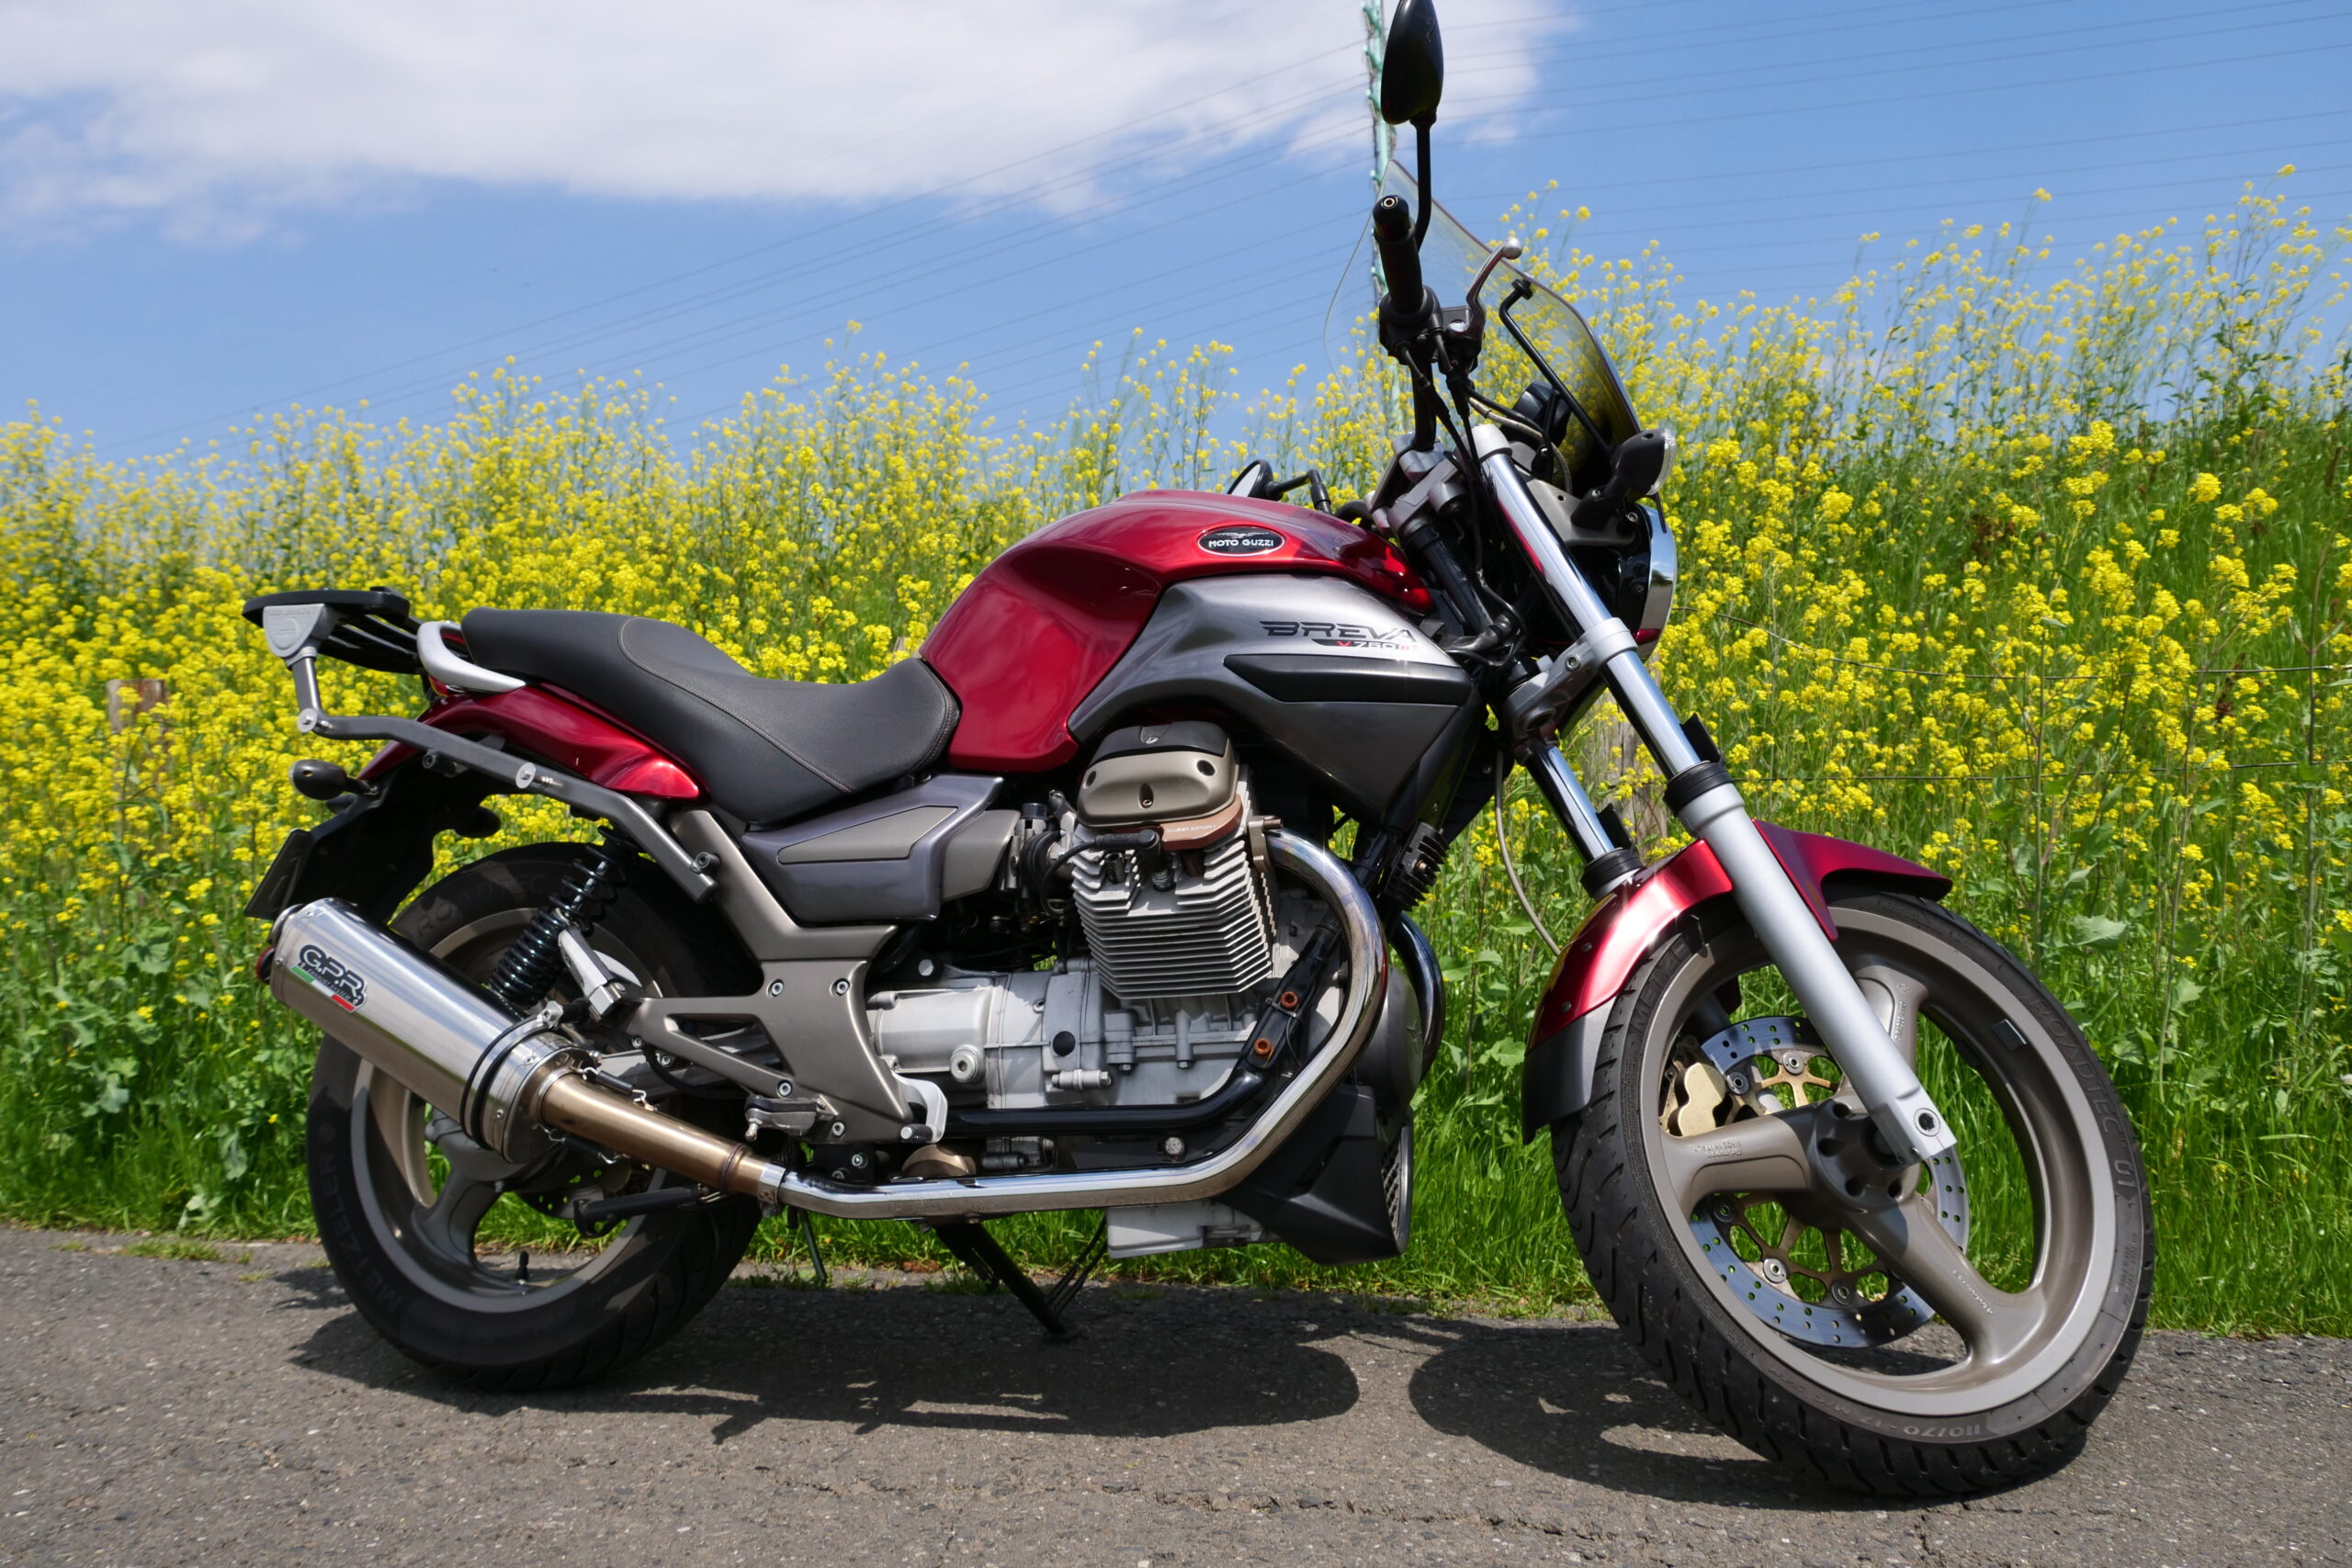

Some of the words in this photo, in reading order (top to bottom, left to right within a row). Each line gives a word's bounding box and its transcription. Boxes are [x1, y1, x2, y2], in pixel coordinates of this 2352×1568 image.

[1208, 539, 1239, 547] MOTO
[1259, 620, 1418, 642] BREVA
[331, 984, 351, 1000] SYSTEM
[2027, 998, 2122, 1133] ROADTEC
[2112, 1159, 2137, 1190] 01
[319, 1151, 403, 1314] METZELER
[1859, 1416, 1883, 1428] 17
[1903, 1424, 1981, 1438] 110/70
